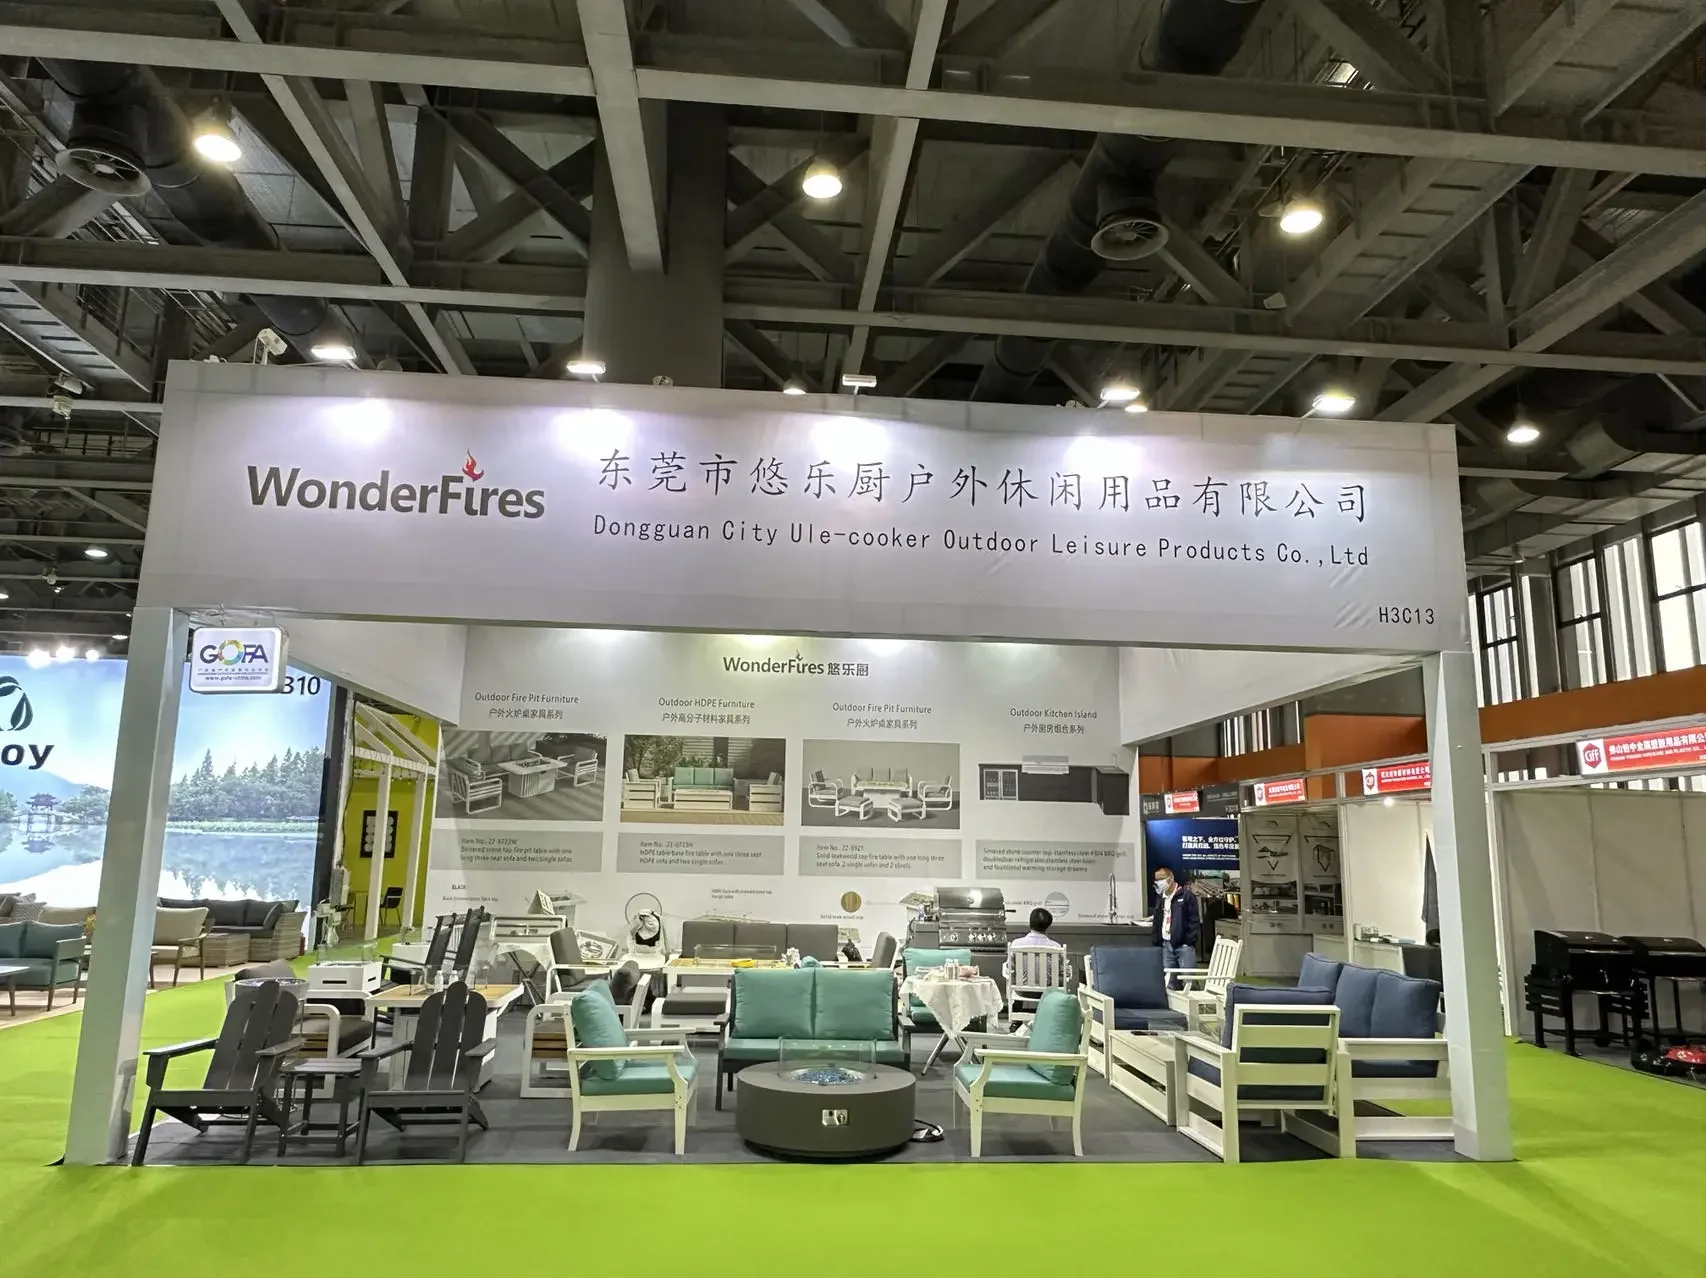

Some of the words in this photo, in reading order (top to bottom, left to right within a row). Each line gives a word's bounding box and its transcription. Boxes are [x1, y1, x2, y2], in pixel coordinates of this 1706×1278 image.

[247, 460, 545, 519] WonderFires
[599, 448, 1365, 522] 东莞市悠乐厨户外休闲用品有限公司
[594, 514, 709, 541] Dongguan
[722, 520, 777, 546] City
[790, 522, 930, 548] Ule-cooker
[943, 528, 1038, 554] Outdoor
[1052, 534, 1147, 558] Leisure
[1159, 538, 1265, 562] Products
[1378, 606, 1436, 625] H3C13
[199, 639, 269, 666] GOFA
[723, 655, 825, 675] WonderFires
[475, 691, 510, 702] Outdoor
[511, 692, 528, 703] Fire
[528, 693, 541, 703] Pit
[541, 694, 579, 704] Furniture
[658, 697, 693, 707] Outdoor
[694, 698, 717, 708] HDPE
[718, 699, 755, 709] Furniture
[832, 702, 866, 713] Outdoor
[867, 703, 882, 713] Fire
[884, 704, 895, 713] Pit
[896, 704, 932, 714] Furniture
[1010, 708, 1043, 718] Outdoor
[1044, 708, 1073, 718] Kitchen
[1074, 709, 1098, 719] Island
